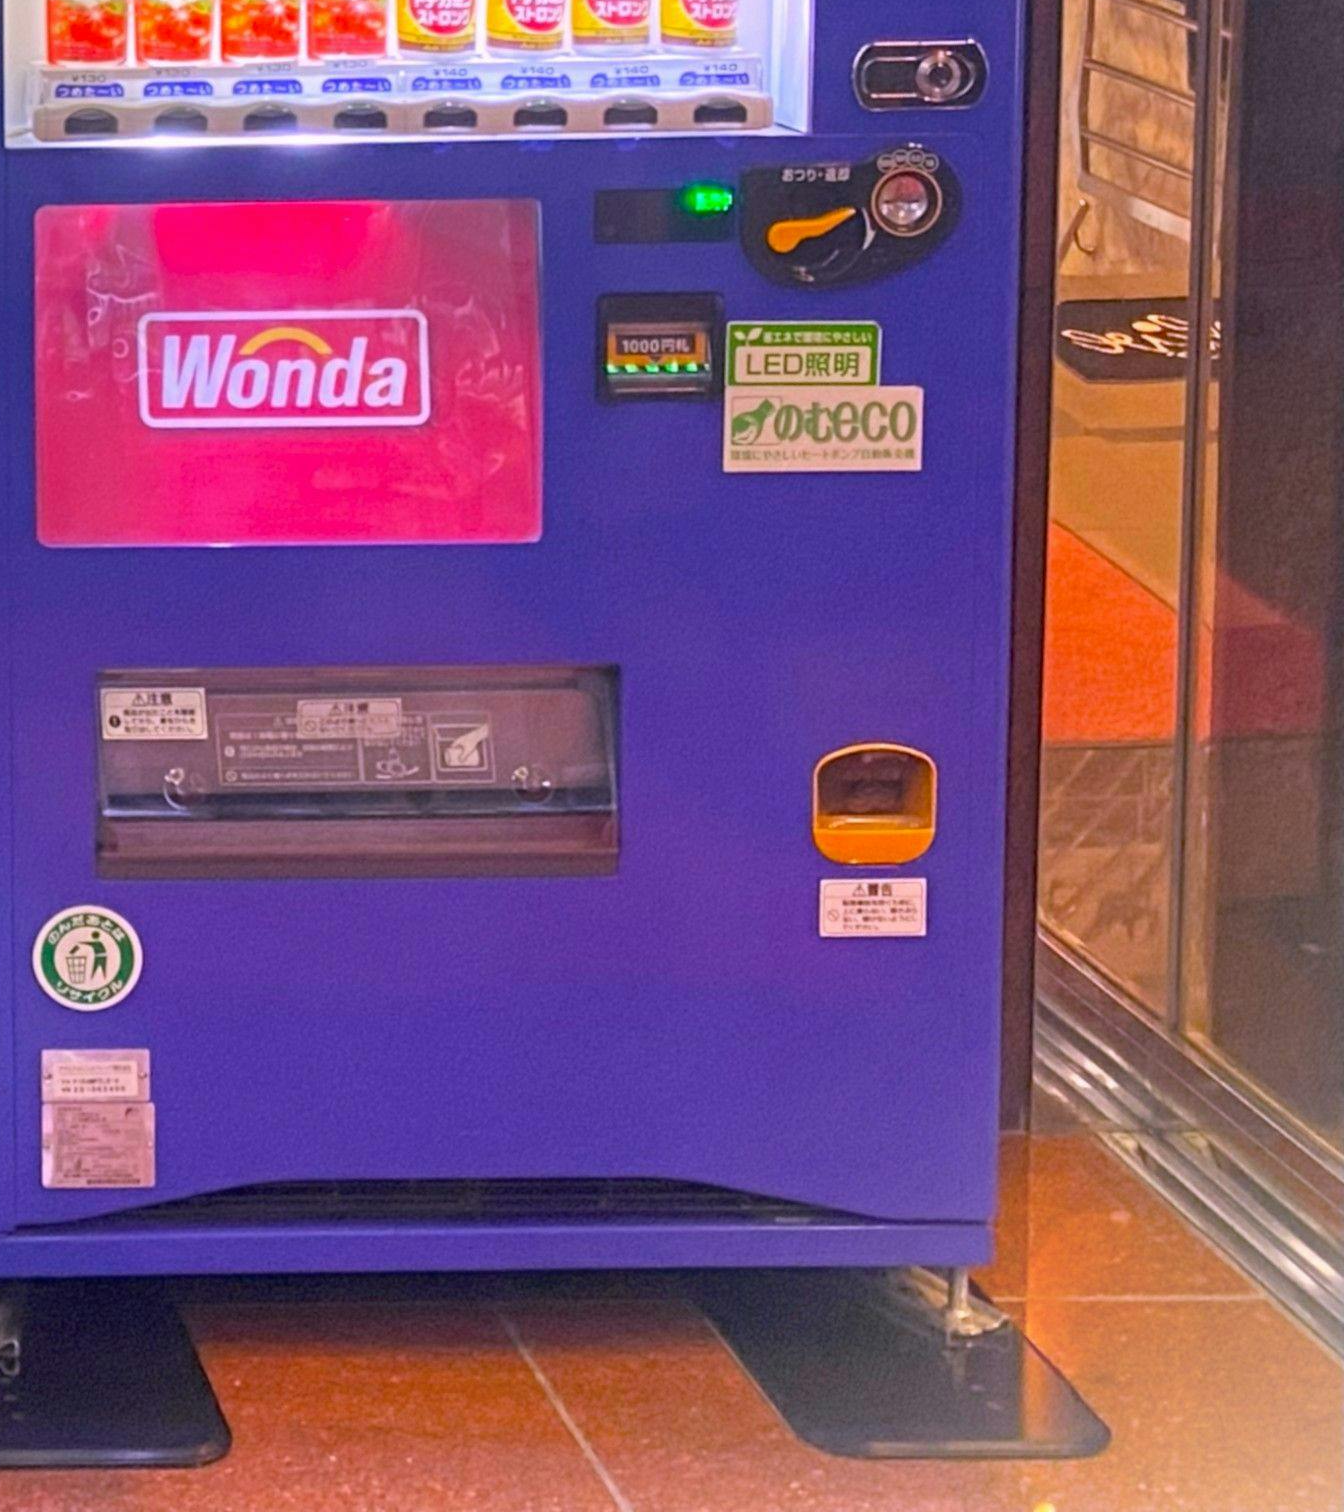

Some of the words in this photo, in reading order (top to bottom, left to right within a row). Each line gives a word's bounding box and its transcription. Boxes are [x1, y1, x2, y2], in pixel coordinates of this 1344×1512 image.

[161, 334, 409, 411] Wonda
[746, 351, 861, 378] LED照明
[773, 399, 918, 444] のむeco
